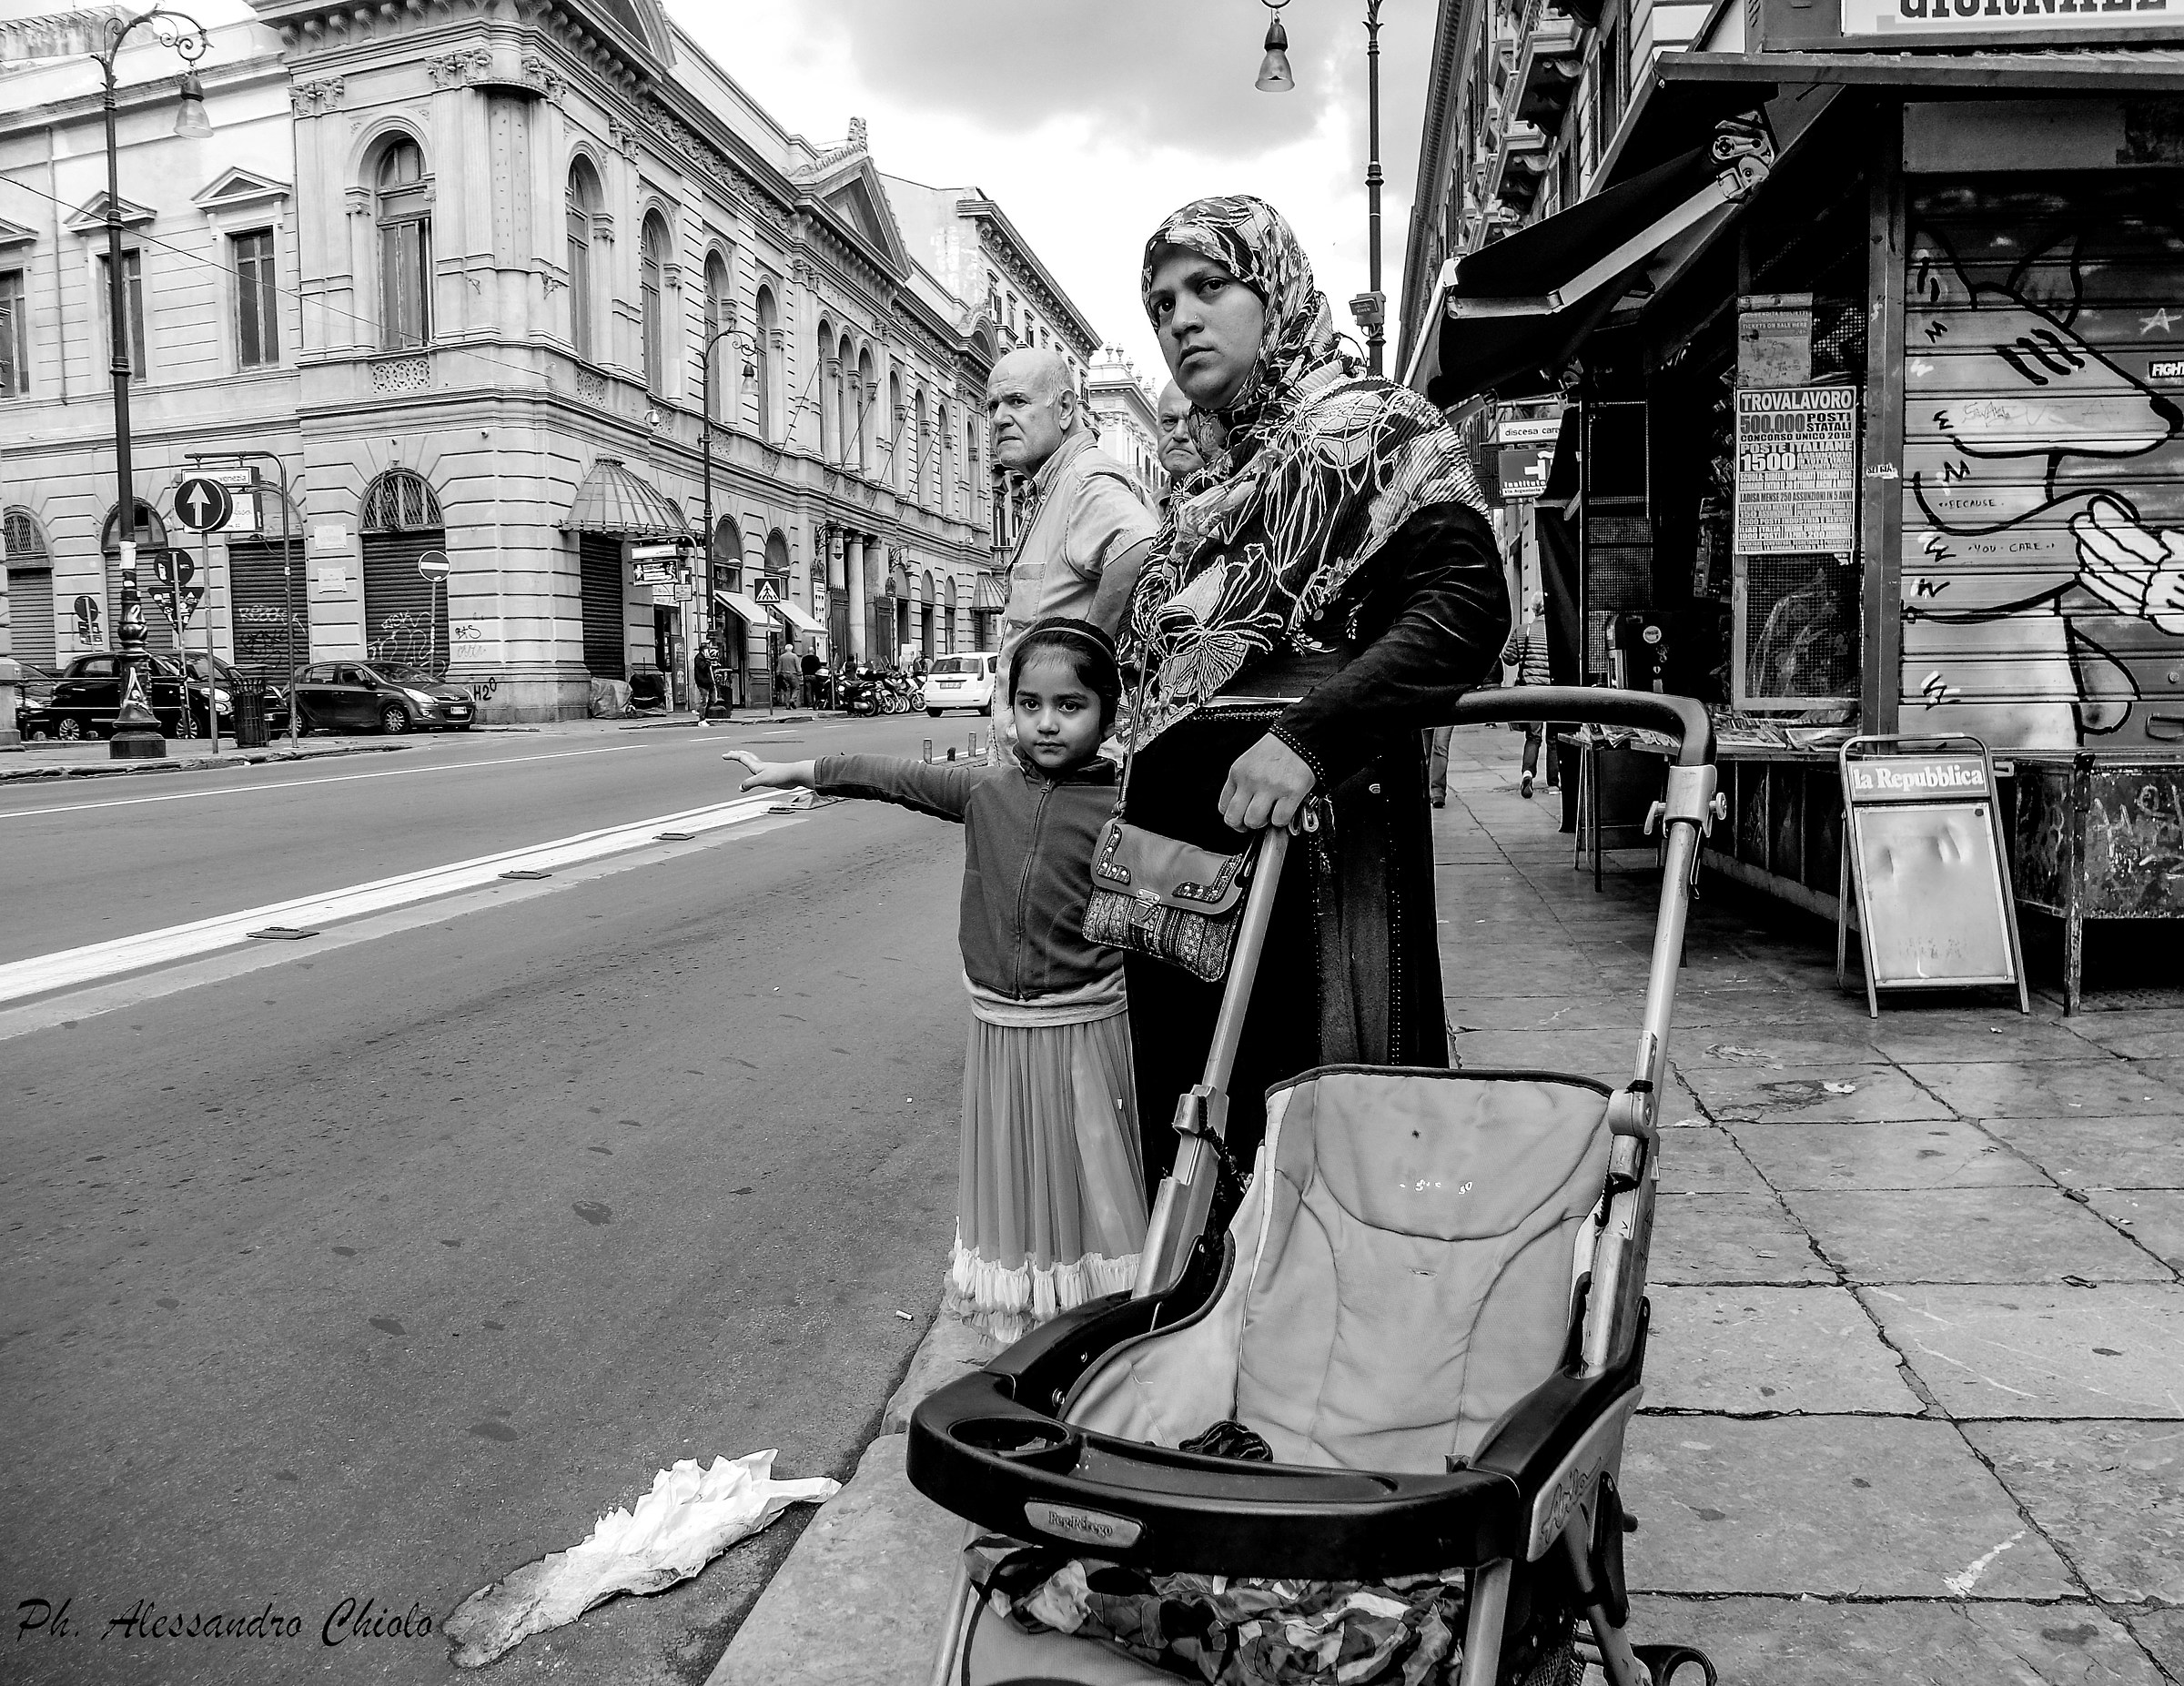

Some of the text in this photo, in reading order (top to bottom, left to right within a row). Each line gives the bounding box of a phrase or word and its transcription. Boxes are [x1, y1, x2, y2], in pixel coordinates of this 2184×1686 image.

[1741, 390, 1853, 411] TROVALAVORO
[1740, 413, 1805, 434] 500.000
[1806, 413, 1851, 422] POSTI
[1504, 428, 1539, 436] discesa
[1806, 422, 1852, 432] STATALI
[1740, 431, 1851, 442] CONCORSO UNICO 2018
[1740, 440, 1853, 454] POSTE ITALIANE
[1740, 452, 1796, 471] 1500
[1761, 492, 1779, 502] MENSE
[1780, 491, 1792, 502] 250
[1834, 491, 1838, 500] 5
[1853, 764, 1984, 792] la Repubblica
